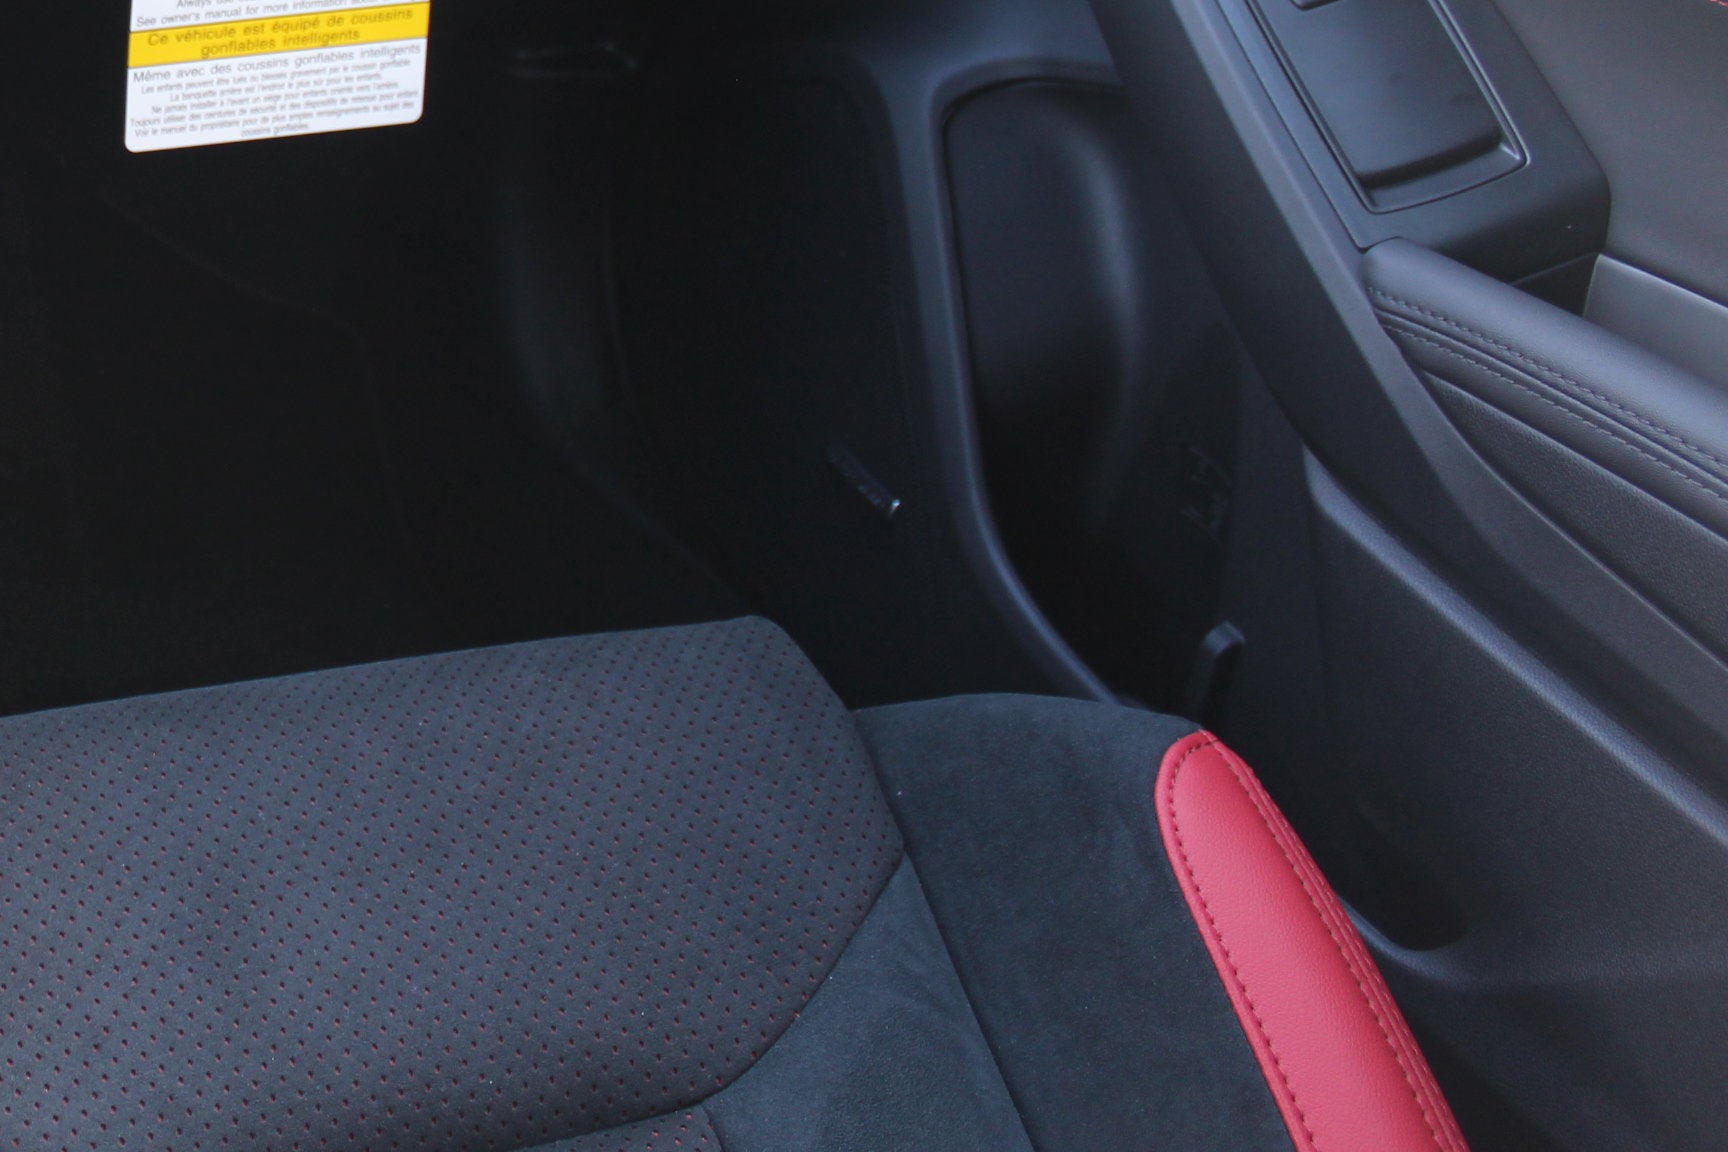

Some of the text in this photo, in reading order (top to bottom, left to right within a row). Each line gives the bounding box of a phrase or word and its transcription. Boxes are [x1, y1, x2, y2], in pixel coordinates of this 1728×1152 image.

[147, 6, 413, 46] Ce véhicule est équipé de coussins
